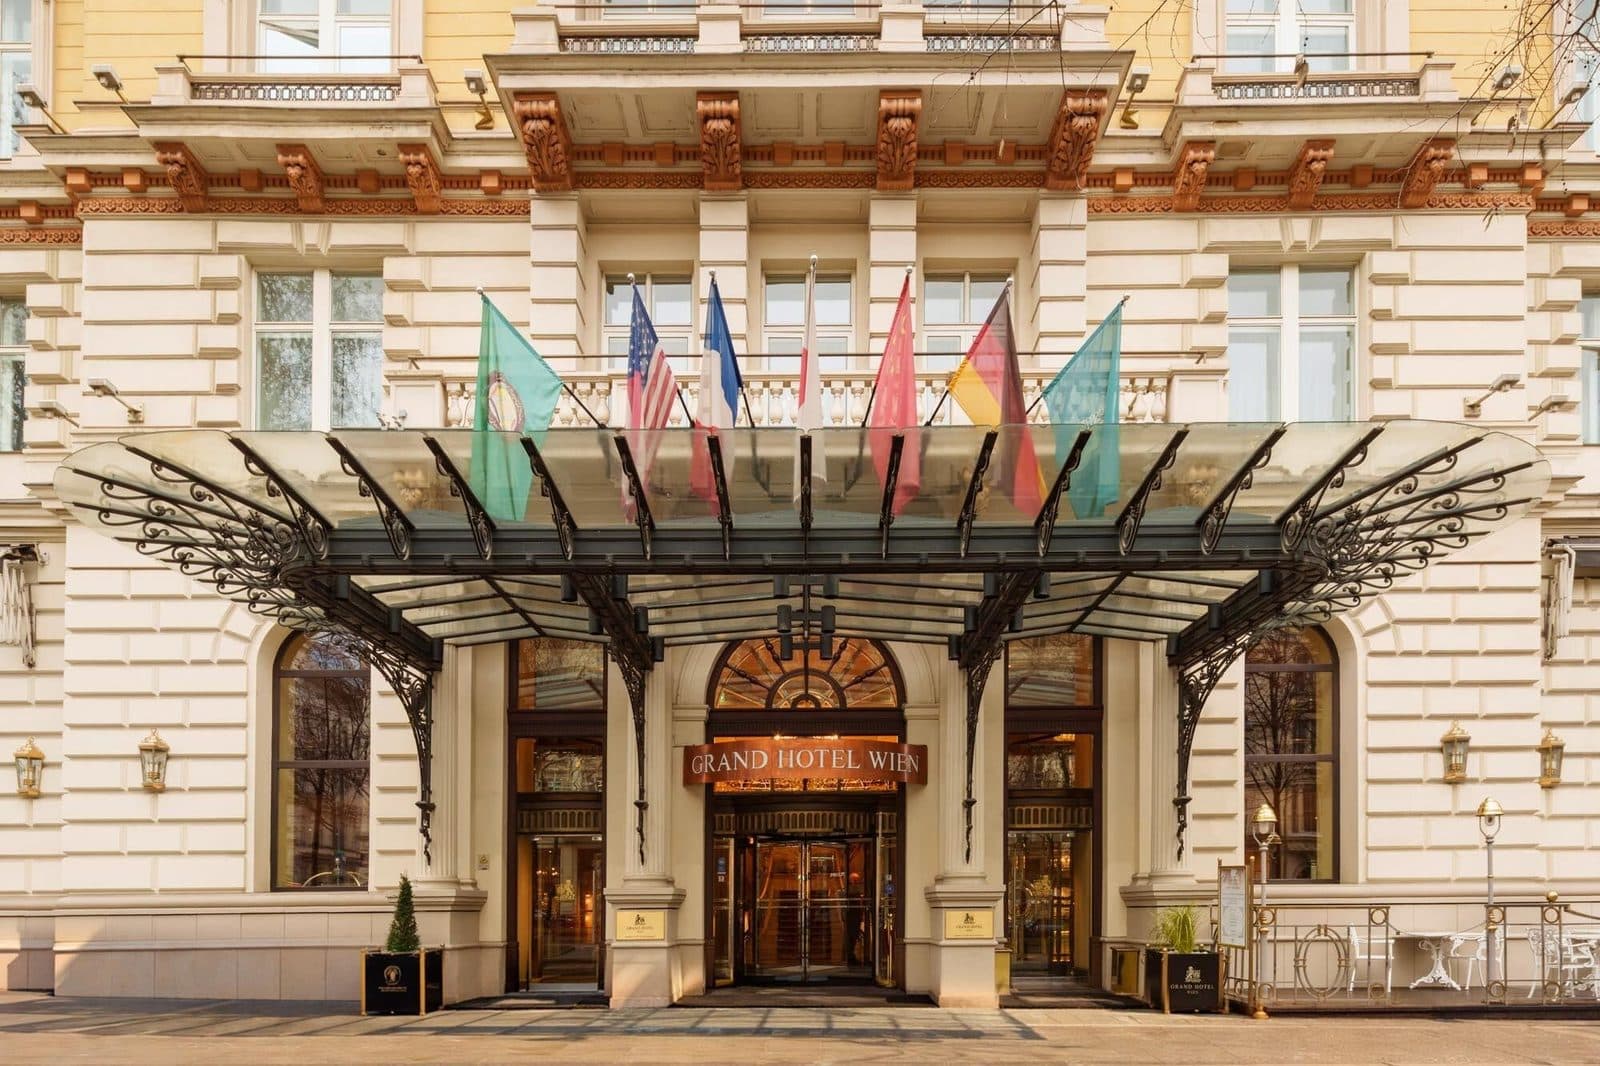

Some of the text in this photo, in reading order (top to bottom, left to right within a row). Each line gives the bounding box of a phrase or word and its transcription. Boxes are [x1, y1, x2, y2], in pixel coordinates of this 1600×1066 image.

[691, 749, 919, 774] GRAND HOTEL WIEN
